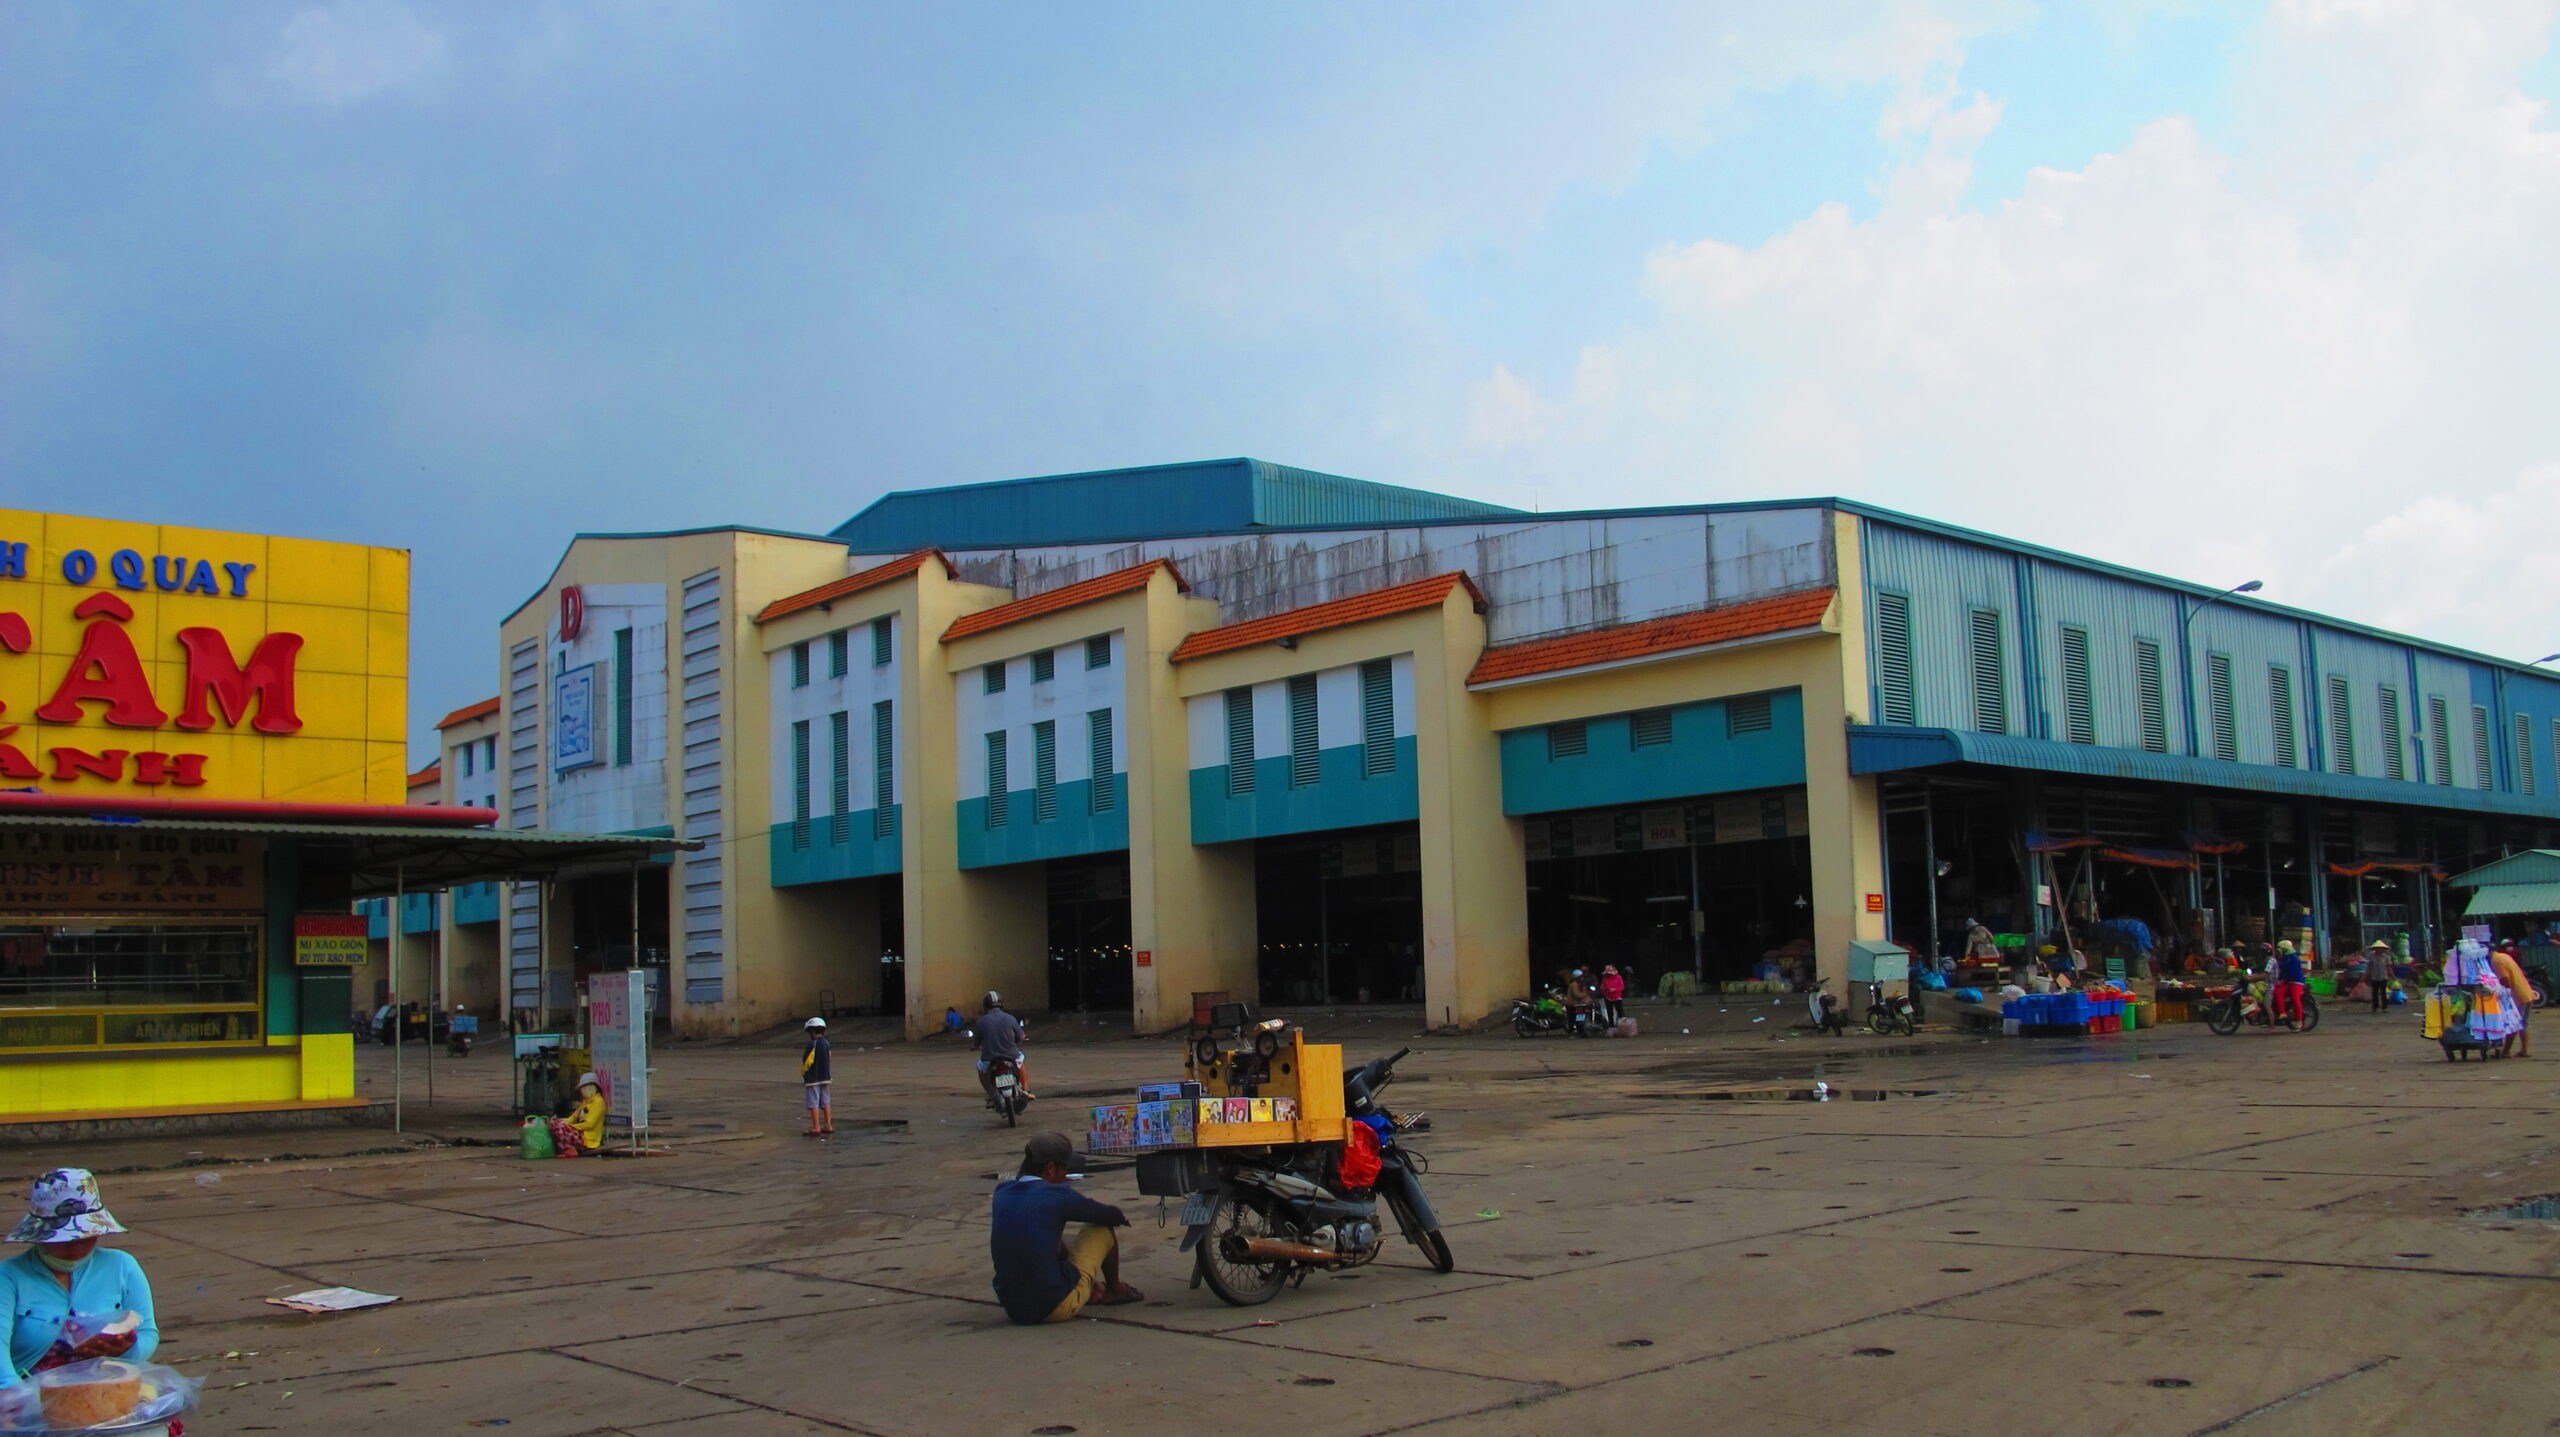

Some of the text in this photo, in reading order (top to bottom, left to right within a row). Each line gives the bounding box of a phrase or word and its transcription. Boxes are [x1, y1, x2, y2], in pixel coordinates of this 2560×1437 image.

[560, 585, 584, 642] D
[190, 837, 241, 856] QUAY
[128, 857, 244, 887] TÂM
